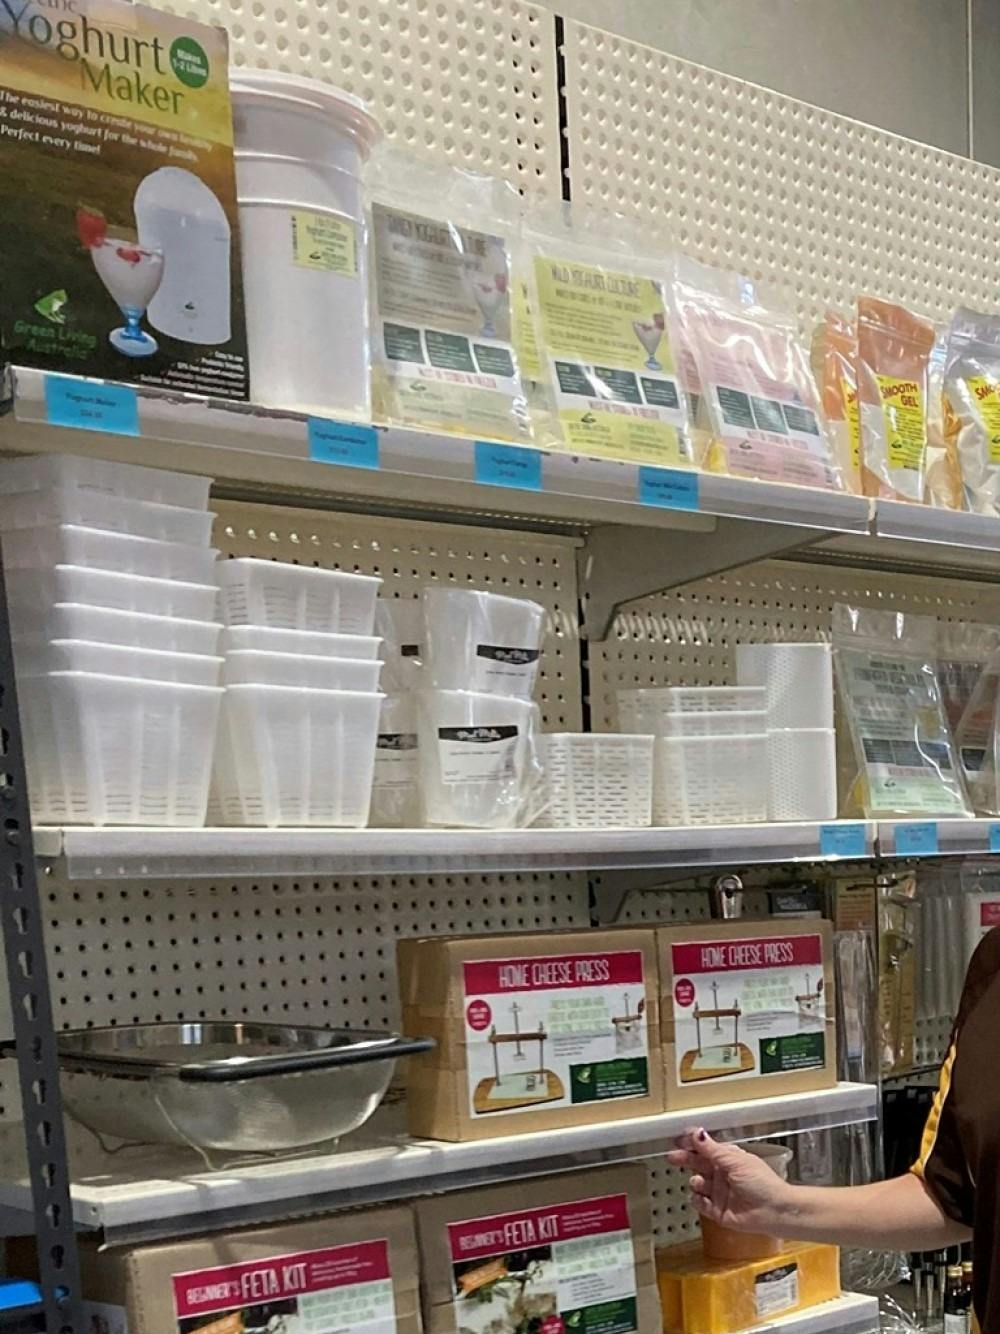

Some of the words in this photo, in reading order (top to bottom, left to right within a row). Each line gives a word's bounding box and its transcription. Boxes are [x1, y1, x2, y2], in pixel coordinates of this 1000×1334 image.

[1, 0, 166, 75] Yoghurt
[80, 58, 185, 114] Maker
[9, 109, 58, 128] delicious
[61, 121, 102, 138] yoghurt
[103, 129, 119, 141] for
[121, 133, 138, 146] the
[87, 110, 98, 121] to
[1, 124, 39, 142] Perfect
[42, 135, 71, 151] every
[880, 383, 918, 399] SMOOTH
[901, 396, 919, 407] GEL
[701, 945, 727, 968] HOME
[729, 943, 763, 966] CHEESE
[764, 942, 794, 963] PRESS
[499, 963, 530, 988] HOME
[532, 960, 573, 985] CHEESE
[575, 959, 610, 982] PRESS
[503, 1218, 536, 1246] FETA
[538, 1214, 560, 1239] KIT
[241, 1267, 280, 1299] FETA
[282, 1262, 308, 1289] KIT
